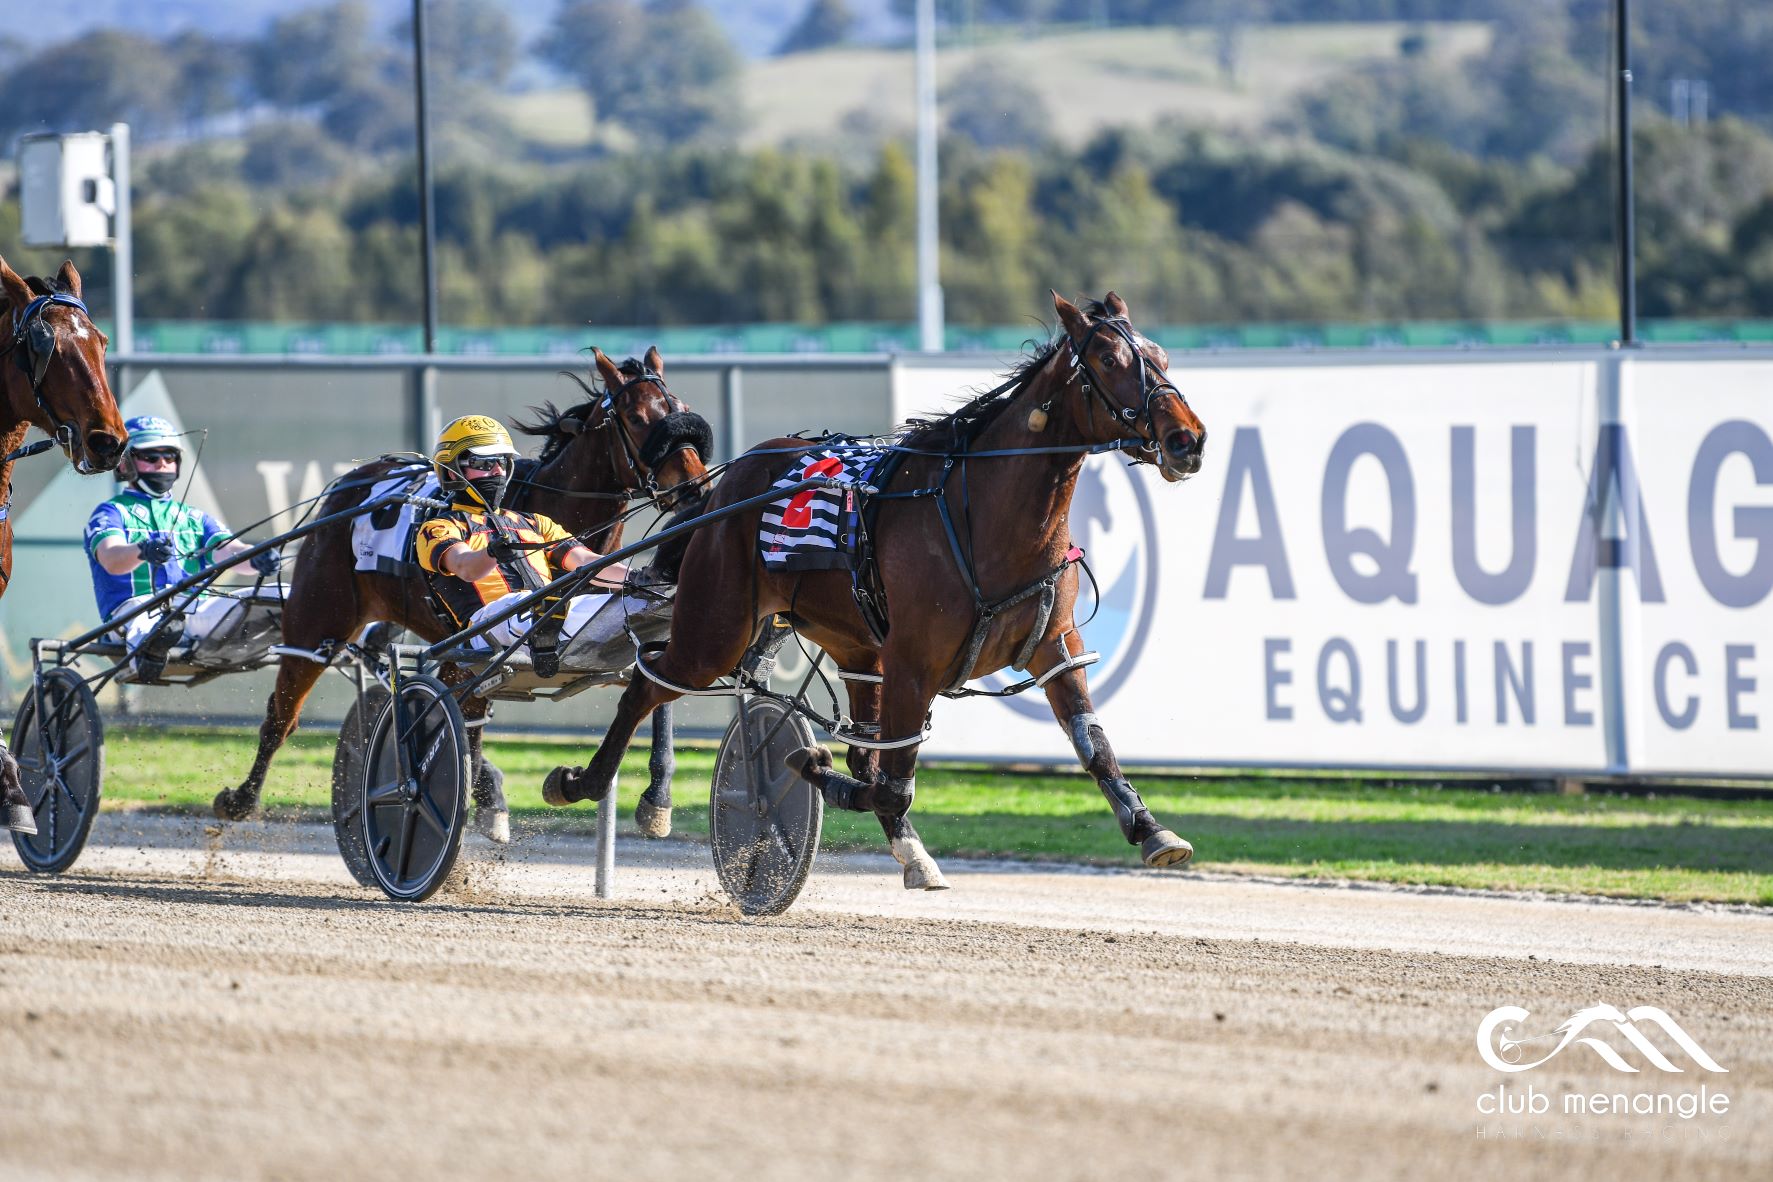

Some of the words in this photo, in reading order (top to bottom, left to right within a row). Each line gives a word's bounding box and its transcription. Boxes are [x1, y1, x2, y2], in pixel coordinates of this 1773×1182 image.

[780, 456, 844, 529] 2
[1202, 419, 1773, 608] AQUAG
[1263, 637, 1594, 727] EQUINE
[1653, 641, 1759, 731] CE
